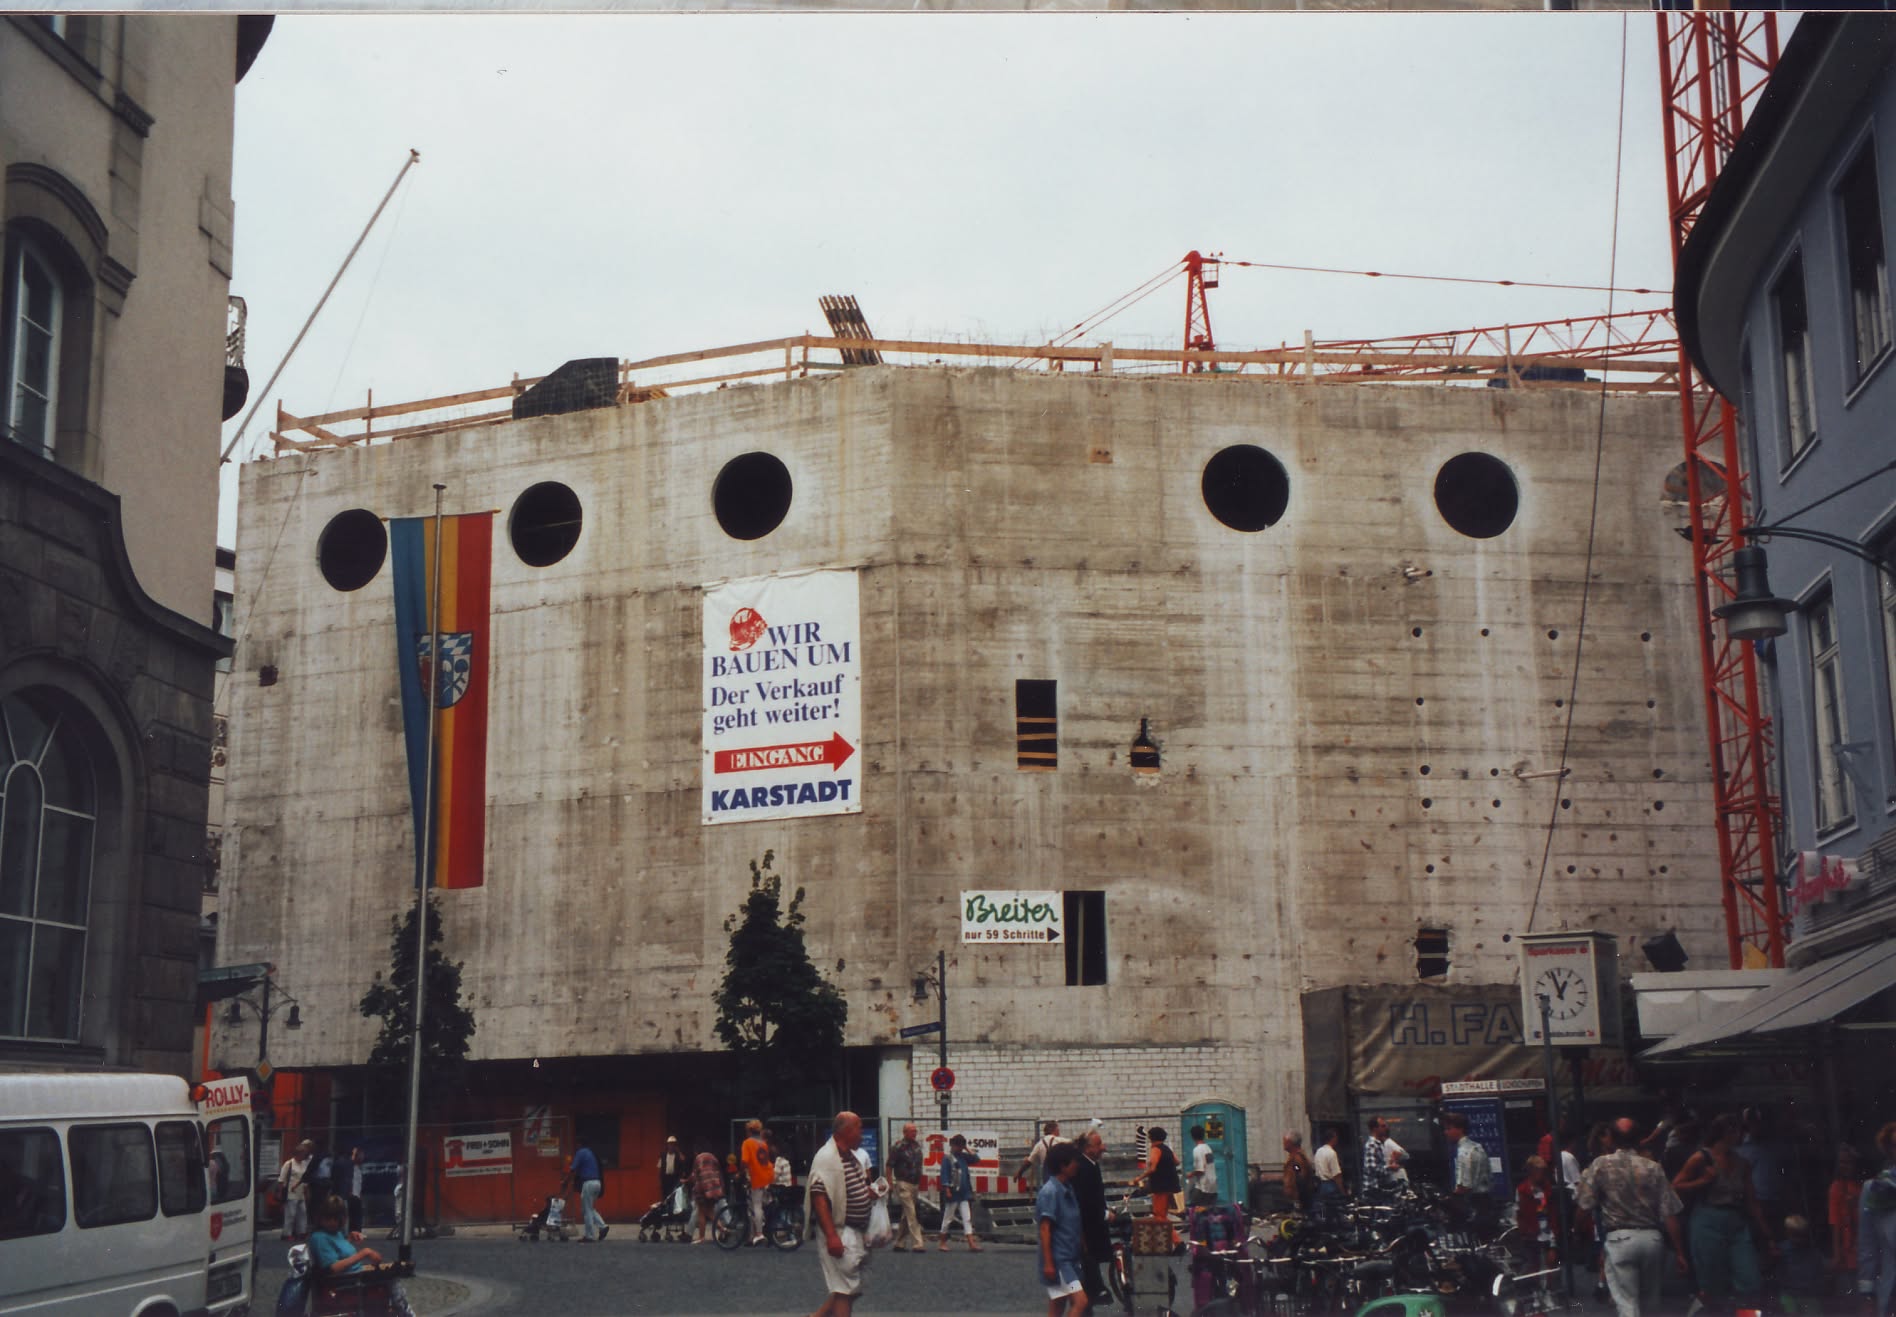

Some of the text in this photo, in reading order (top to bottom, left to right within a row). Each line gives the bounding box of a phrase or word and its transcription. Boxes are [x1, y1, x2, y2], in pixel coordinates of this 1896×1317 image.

[768, 622, 821, 647] WIR
[711, 641, 851, 677] BAUEN UM
[711, 674, 845, 707] Der Verkauf
[713, 698, 841, 735] geht weiter!
[731, 745, 824, 769] EINGANG
[711, 779, 852, 811] KARSTADT
[966, 894, 1059, 923] Breiter
[965, 930, 1045, 939] nur 59 Schritte
[973, 1138, 997, 1148] SOHN
